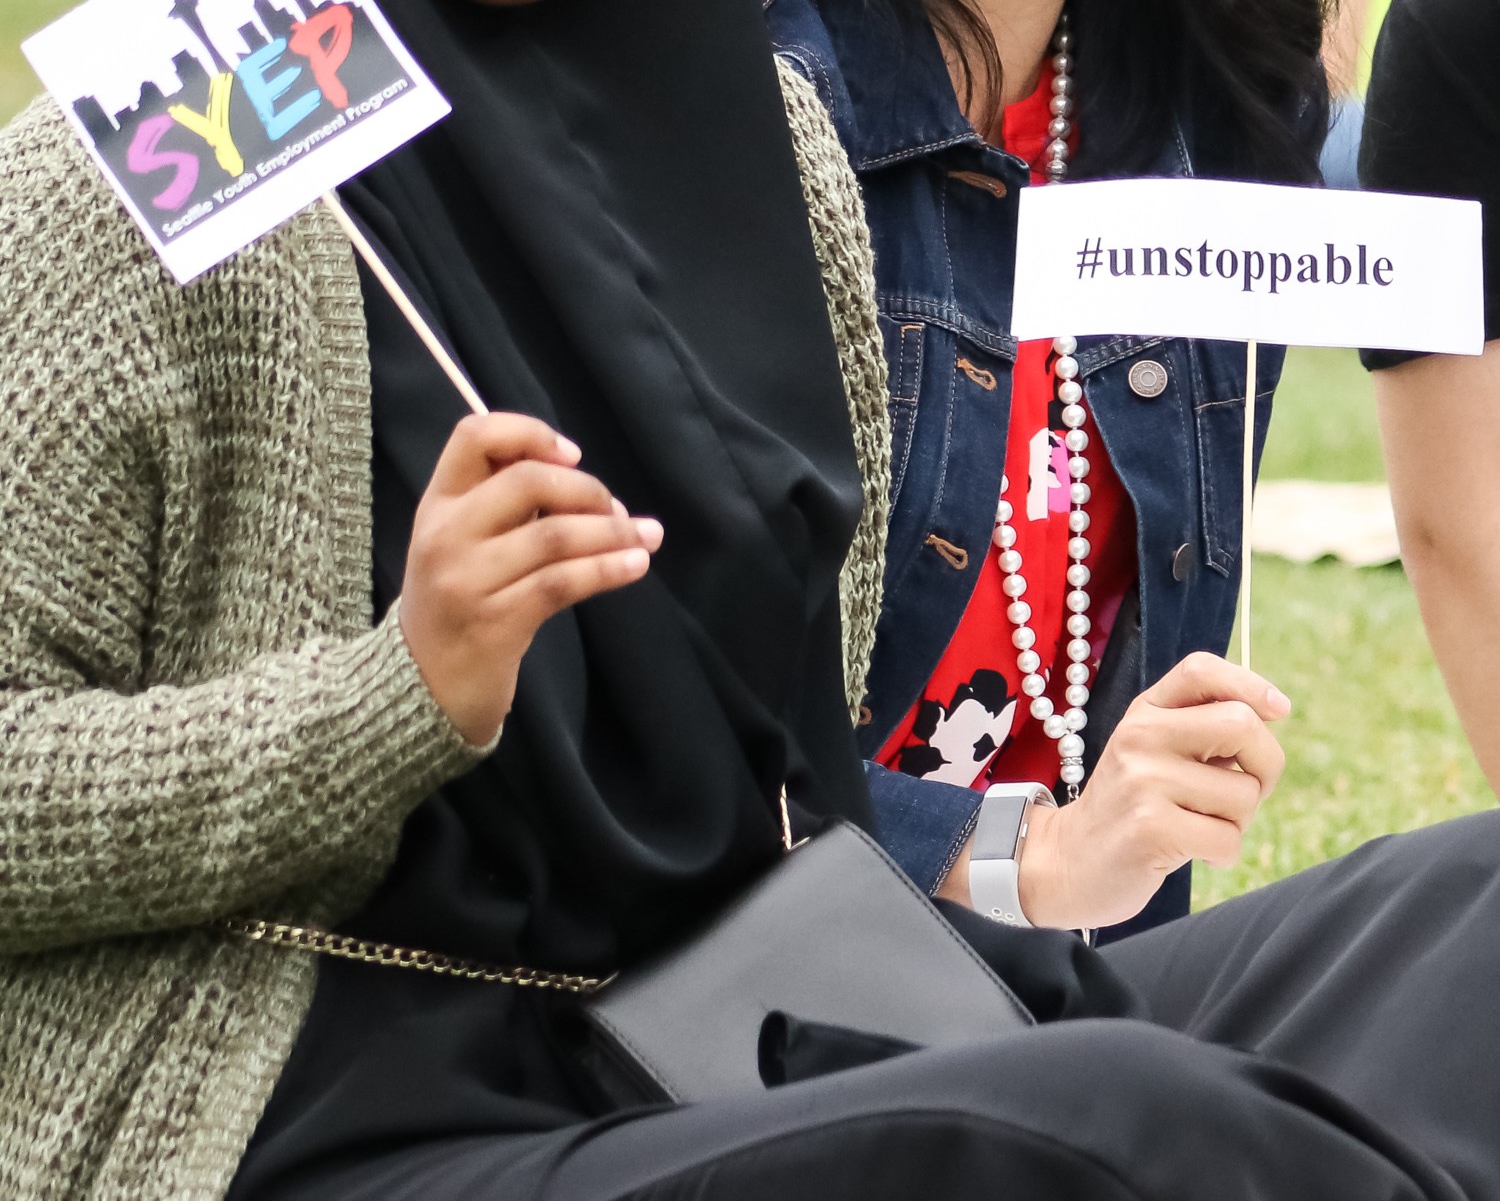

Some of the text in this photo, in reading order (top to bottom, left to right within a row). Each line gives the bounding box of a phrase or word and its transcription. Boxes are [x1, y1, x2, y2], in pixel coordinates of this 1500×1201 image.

[127, 3, 354, 211] SYEP
[162, 78, 408, 238] Seattle Youth Employment Program
[1076, 237, 1394, 294] #unstoppable
